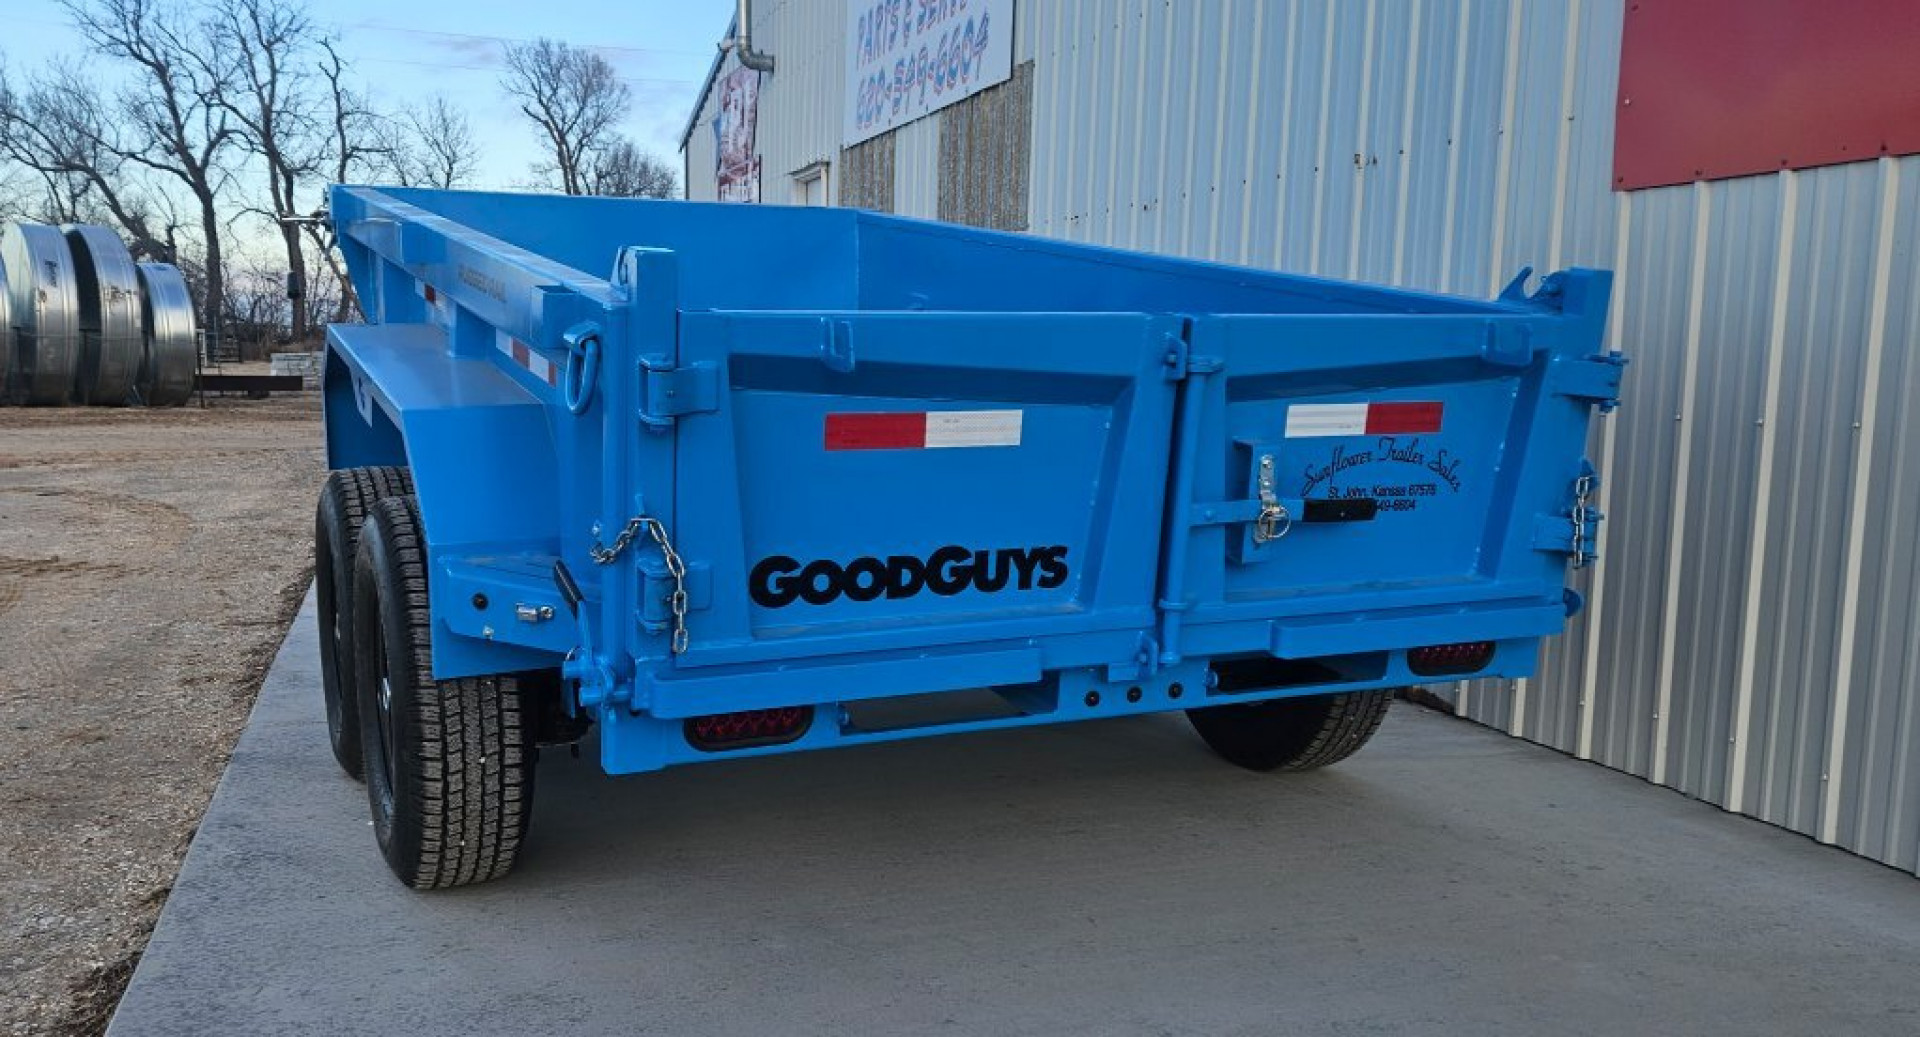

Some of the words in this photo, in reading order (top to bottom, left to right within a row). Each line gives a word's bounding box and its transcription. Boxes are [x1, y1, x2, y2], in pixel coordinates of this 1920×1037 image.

[1301, 444, 1373, 496] Sunflower
[1376, 436, 1424, 464] Trailer
[1427, 449, 1461, 493] Sales
